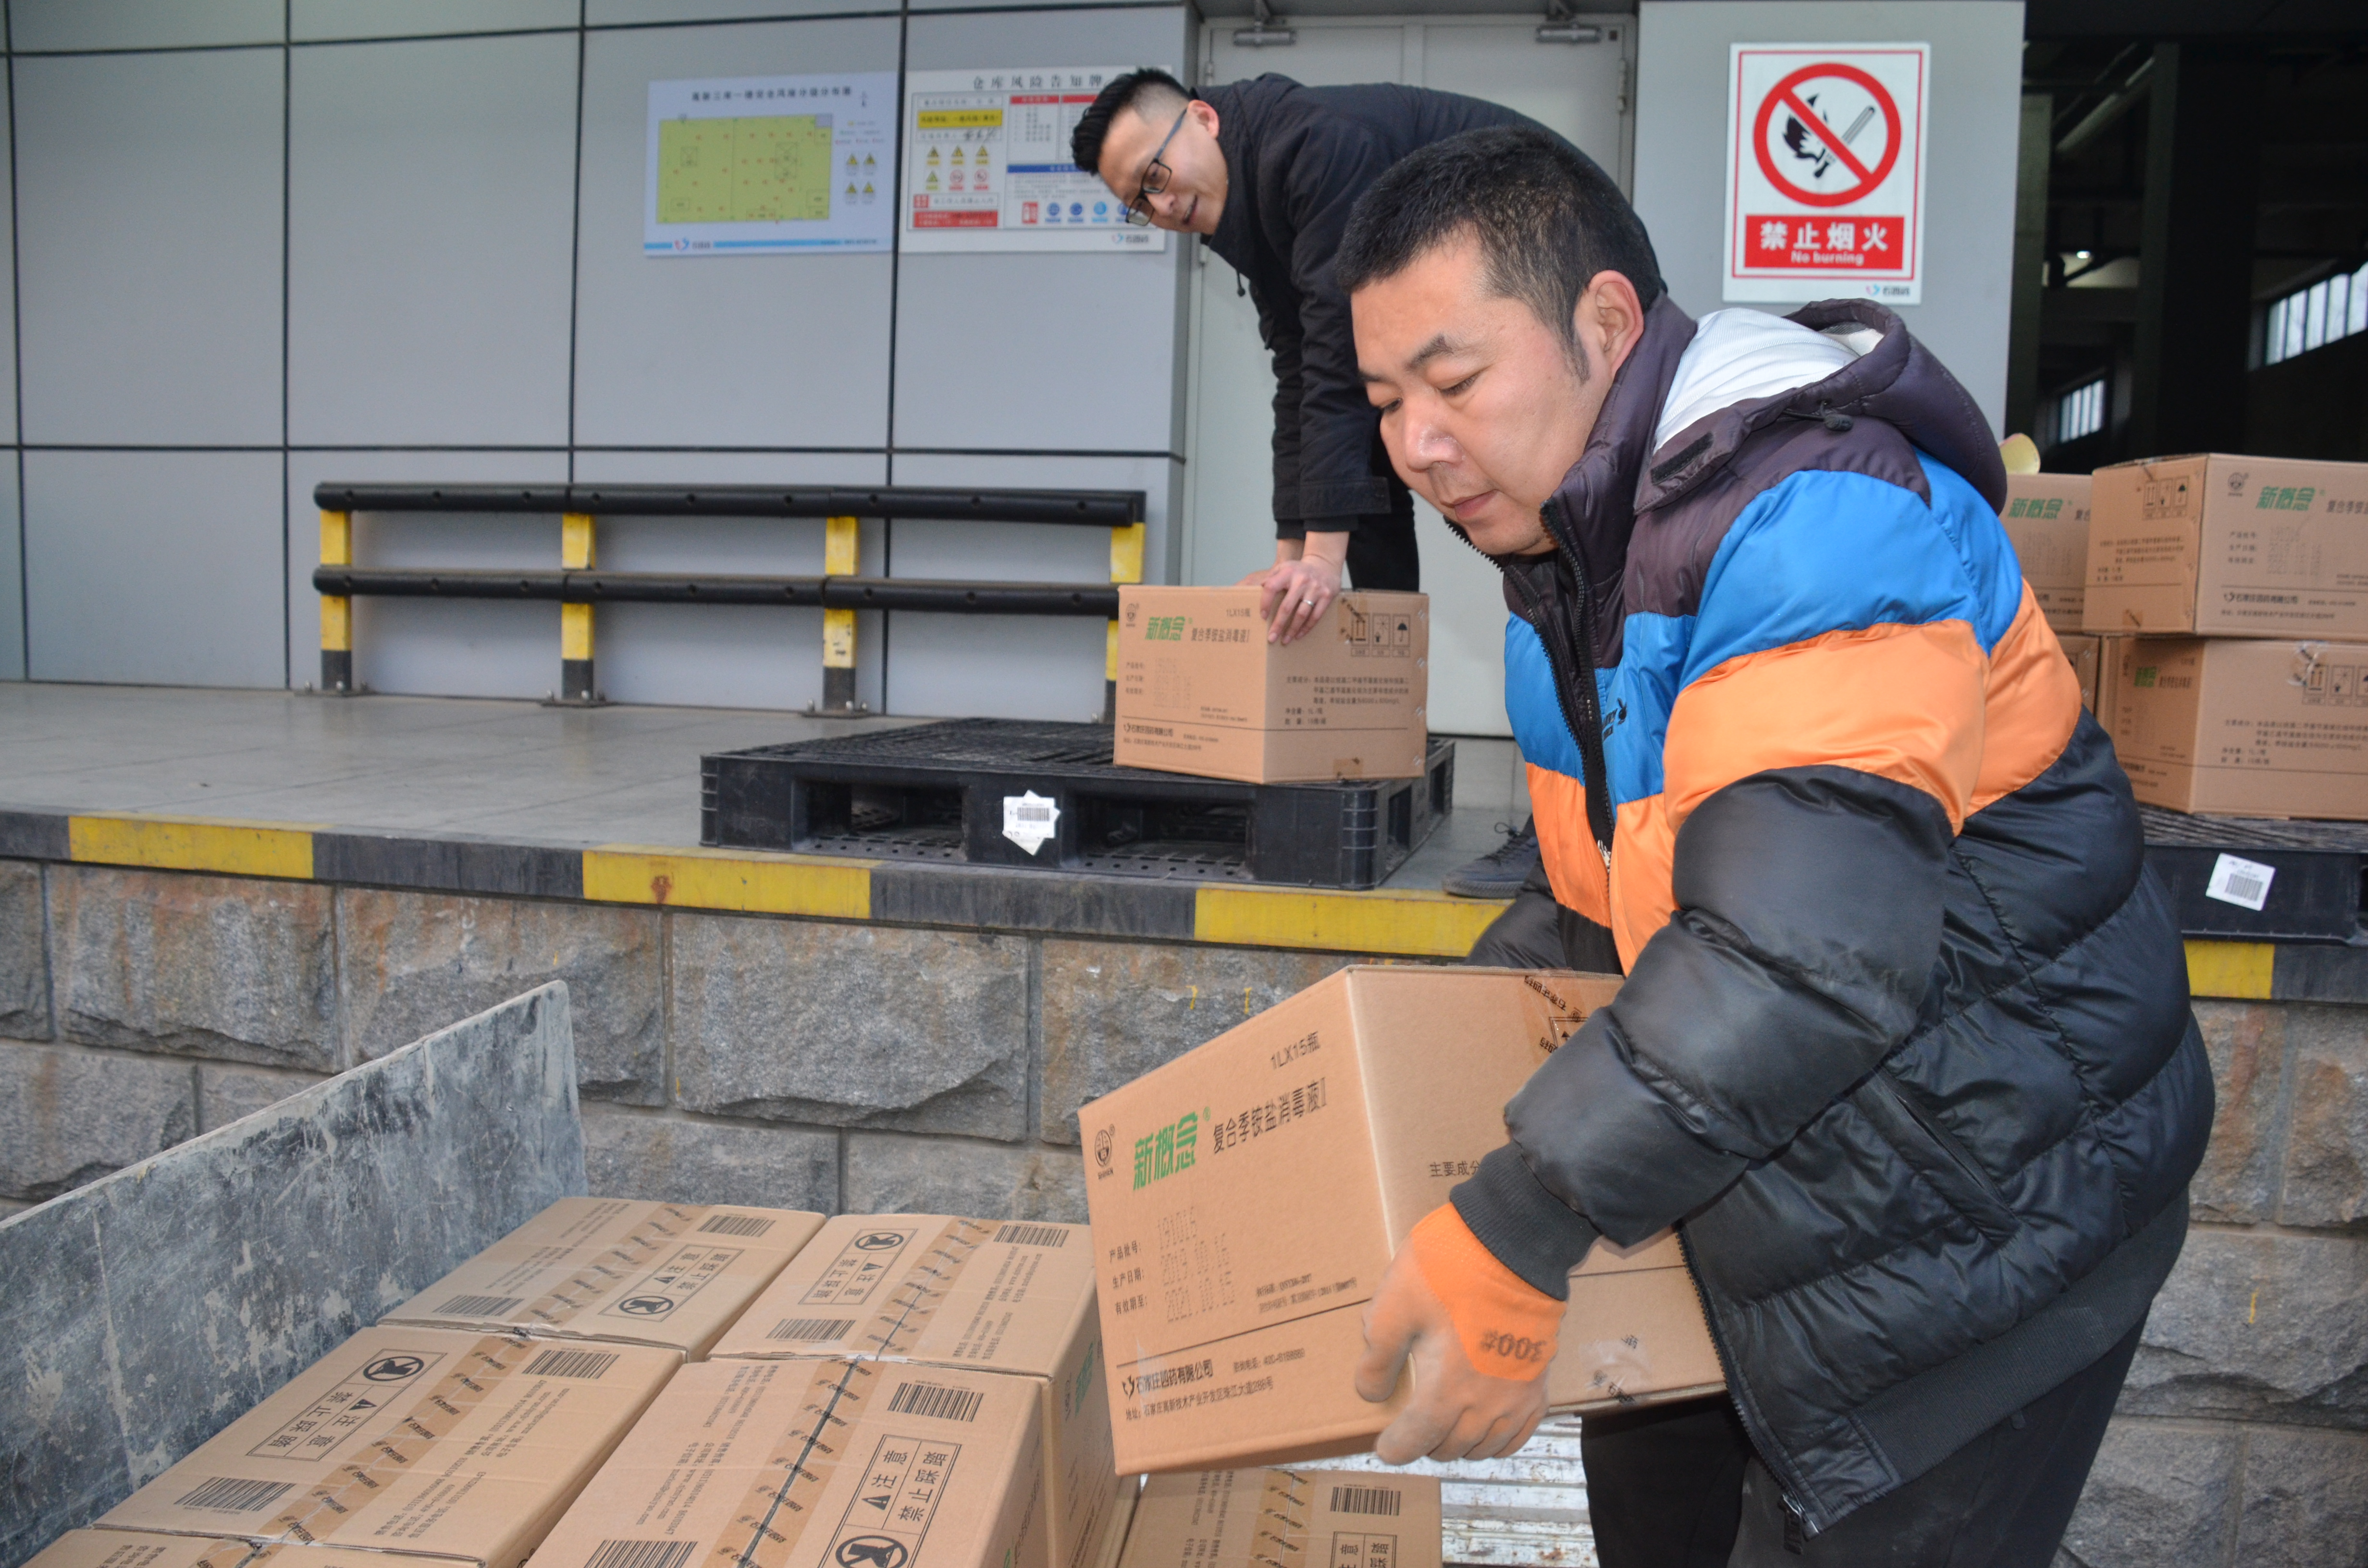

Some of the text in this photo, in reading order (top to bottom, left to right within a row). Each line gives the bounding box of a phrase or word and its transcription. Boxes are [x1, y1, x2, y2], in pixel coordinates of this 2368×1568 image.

[974, 74, 1103, 89] 仓库风险告知牌
[1760, 221, 1888, 251] 禁止烟火
[1791, 251, 1864, 267] No burning
[2008, 498, 2063, 519] 新概念
[2256, 486, 2316, 511] 新概念
[1145, 616, 1185, 641] 新概念
[1524, 975, 1566, 1011] 石家庄四药
[1270, 1031, 1321, 1069] 1LX15瓶
[1133, 1111, 1198, 1191] 新概念
[1430, 1160, 1480, 1177] 主要成分
[1109, 1240, 1141, 1263] 产品批号:
[1112, 1267, 1144, 1289] 生产日期:
[1115, 1294, 1147, 1315] 有效期至:
[1135, 1359, 1214, 1394] 石家庄四药有限公司
[266, 1391, 353, 1447] 禁止踩踏
[310, 1415, 362, 1447] 注意
[872, 1450, 908, 1491] 注意
[898, 1451, 950, 1523] 禁止踩踏
